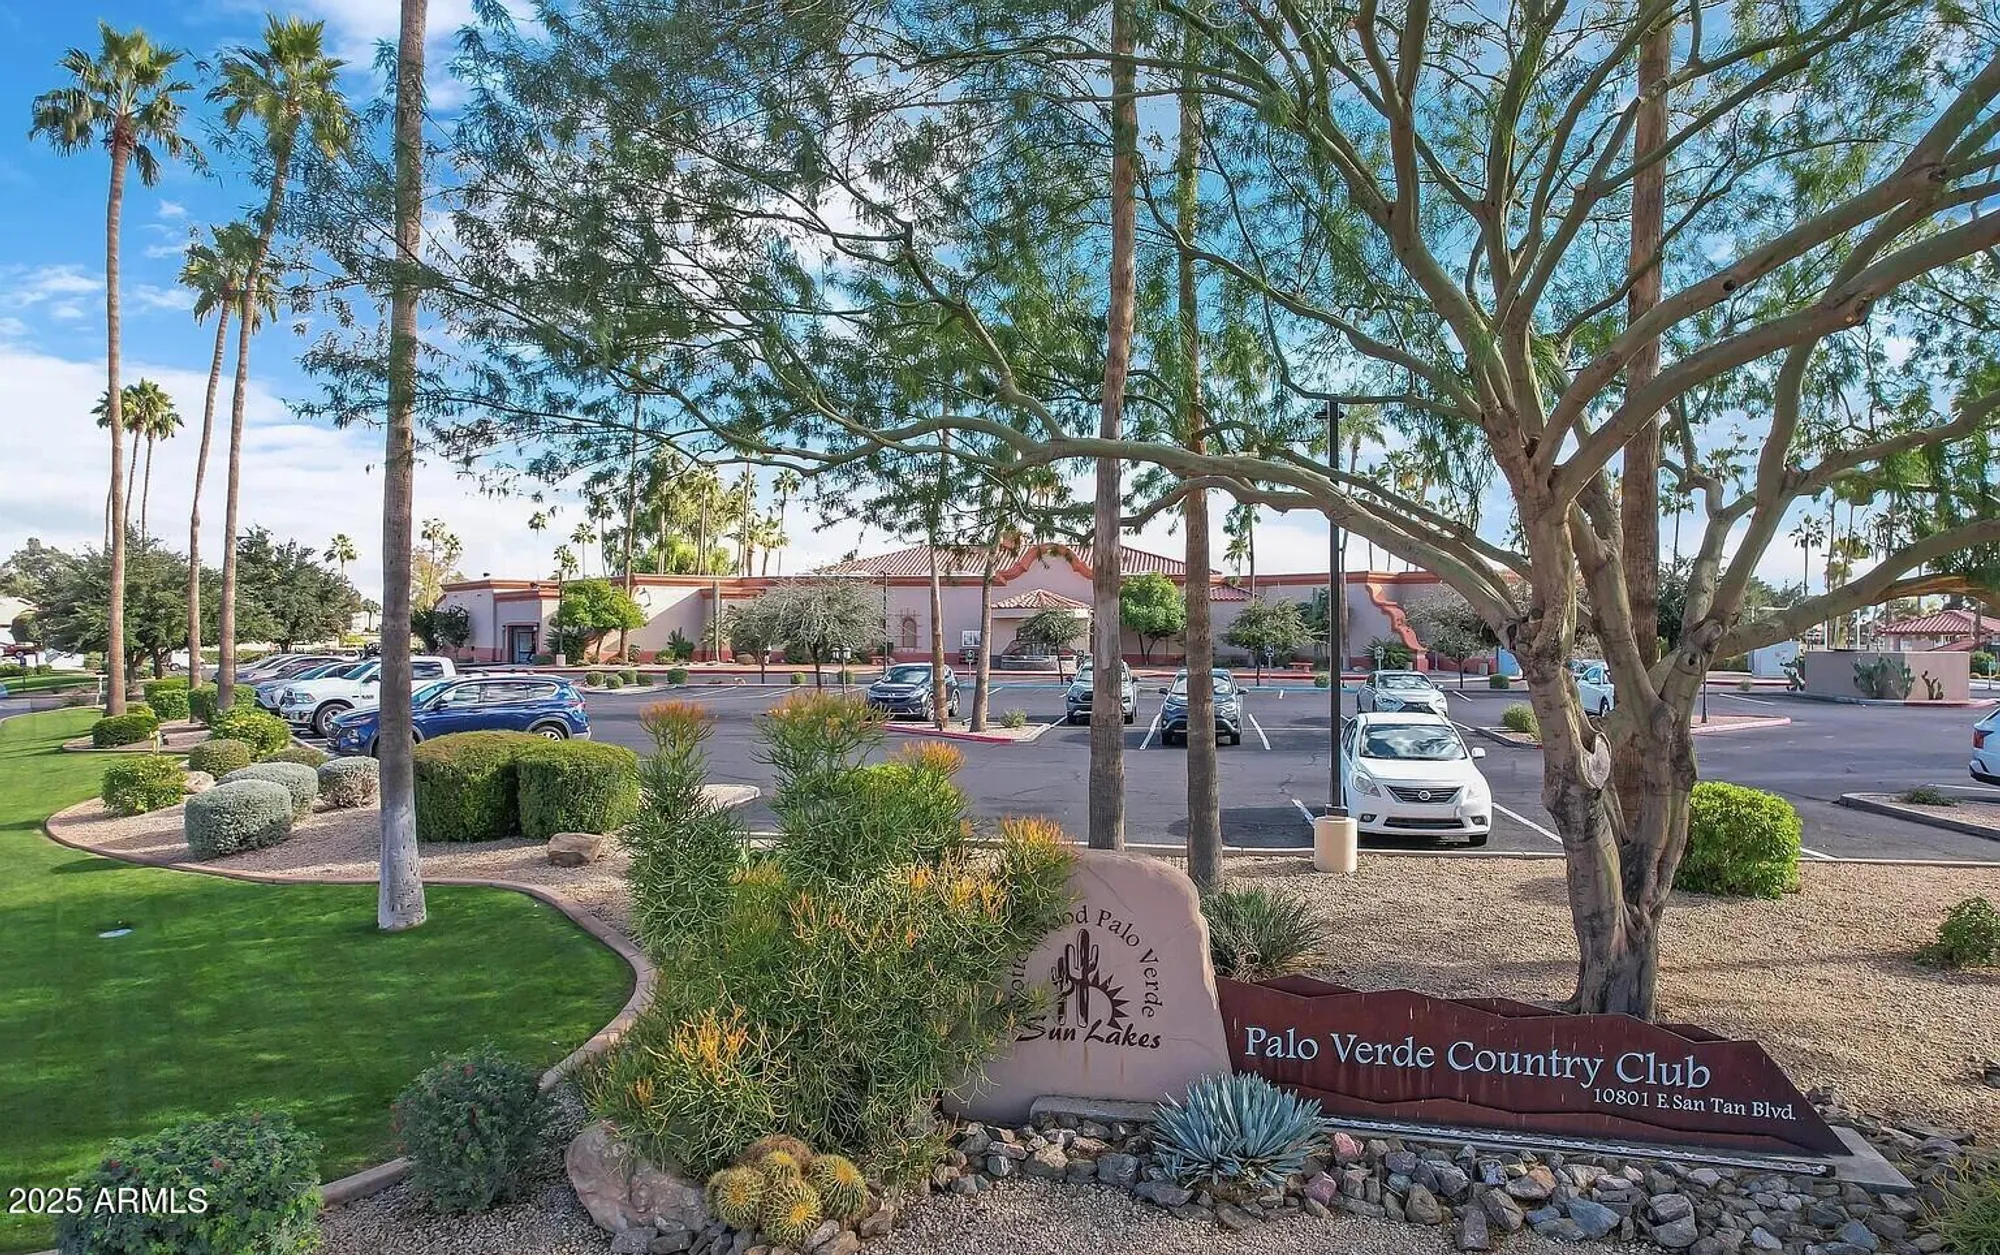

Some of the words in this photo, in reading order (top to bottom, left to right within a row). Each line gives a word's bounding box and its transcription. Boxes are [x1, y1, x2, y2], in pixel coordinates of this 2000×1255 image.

[1096, 908, 1140, 947] Palo
[1138, 947, 1163, 1018] Verde
[1014, 1015, 1076, 1043] Sun
[1083, 1018, 1162, 1049] Lakes
[1244, 1027, 1319, 1060] Palo
[1330, 1032, 1435, 1068] Verde
[1447, 1040, 1604, 1089] Country
[1614, 1051, 1711, 1089] Club
[1593, 1088, 1649, 1108] 10801
[1710, 1097, 1747, 1116] Tan
[1751, 1101, 1797, 1121] Blvd.
